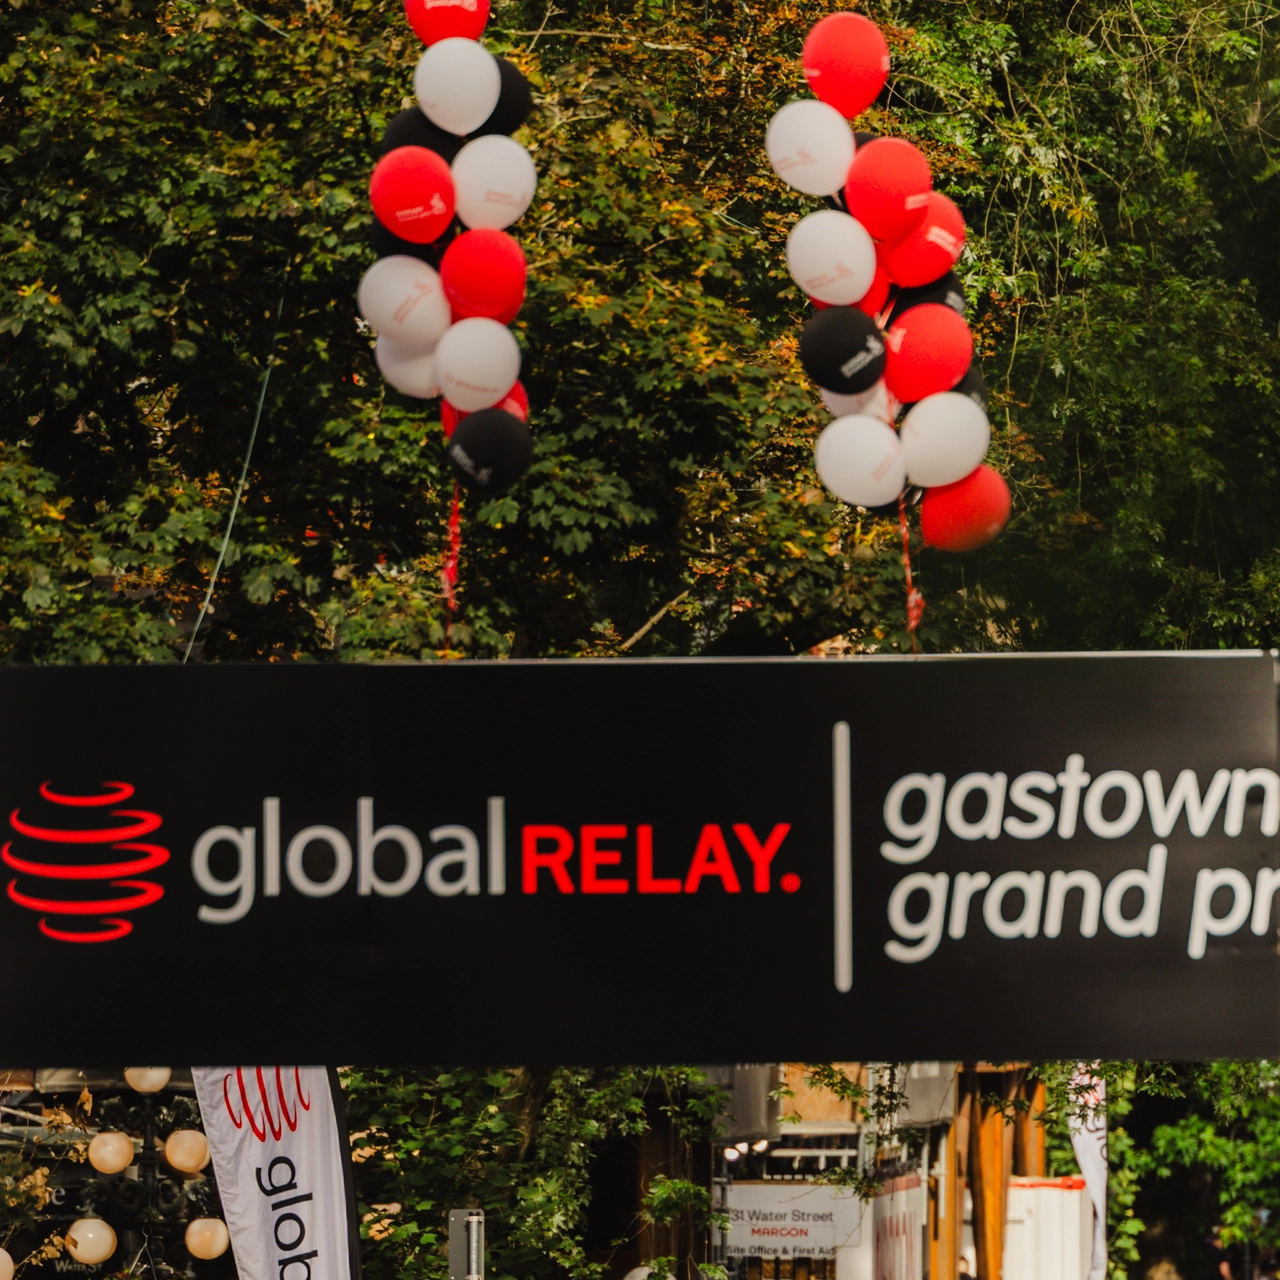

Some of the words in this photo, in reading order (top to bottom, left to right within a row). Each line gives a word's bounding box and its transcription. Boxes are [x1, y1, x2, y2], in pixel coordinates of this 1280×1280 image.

[884, 843, 1169, 962] grand
[729, 1209, 745, 1222] 31
[748, 1209, 788, 1222] Water
[792, 1209, 834, 1222] Street
[748, 1244, 778, 1255] Office
[792, 1244, 815, 1255] First
